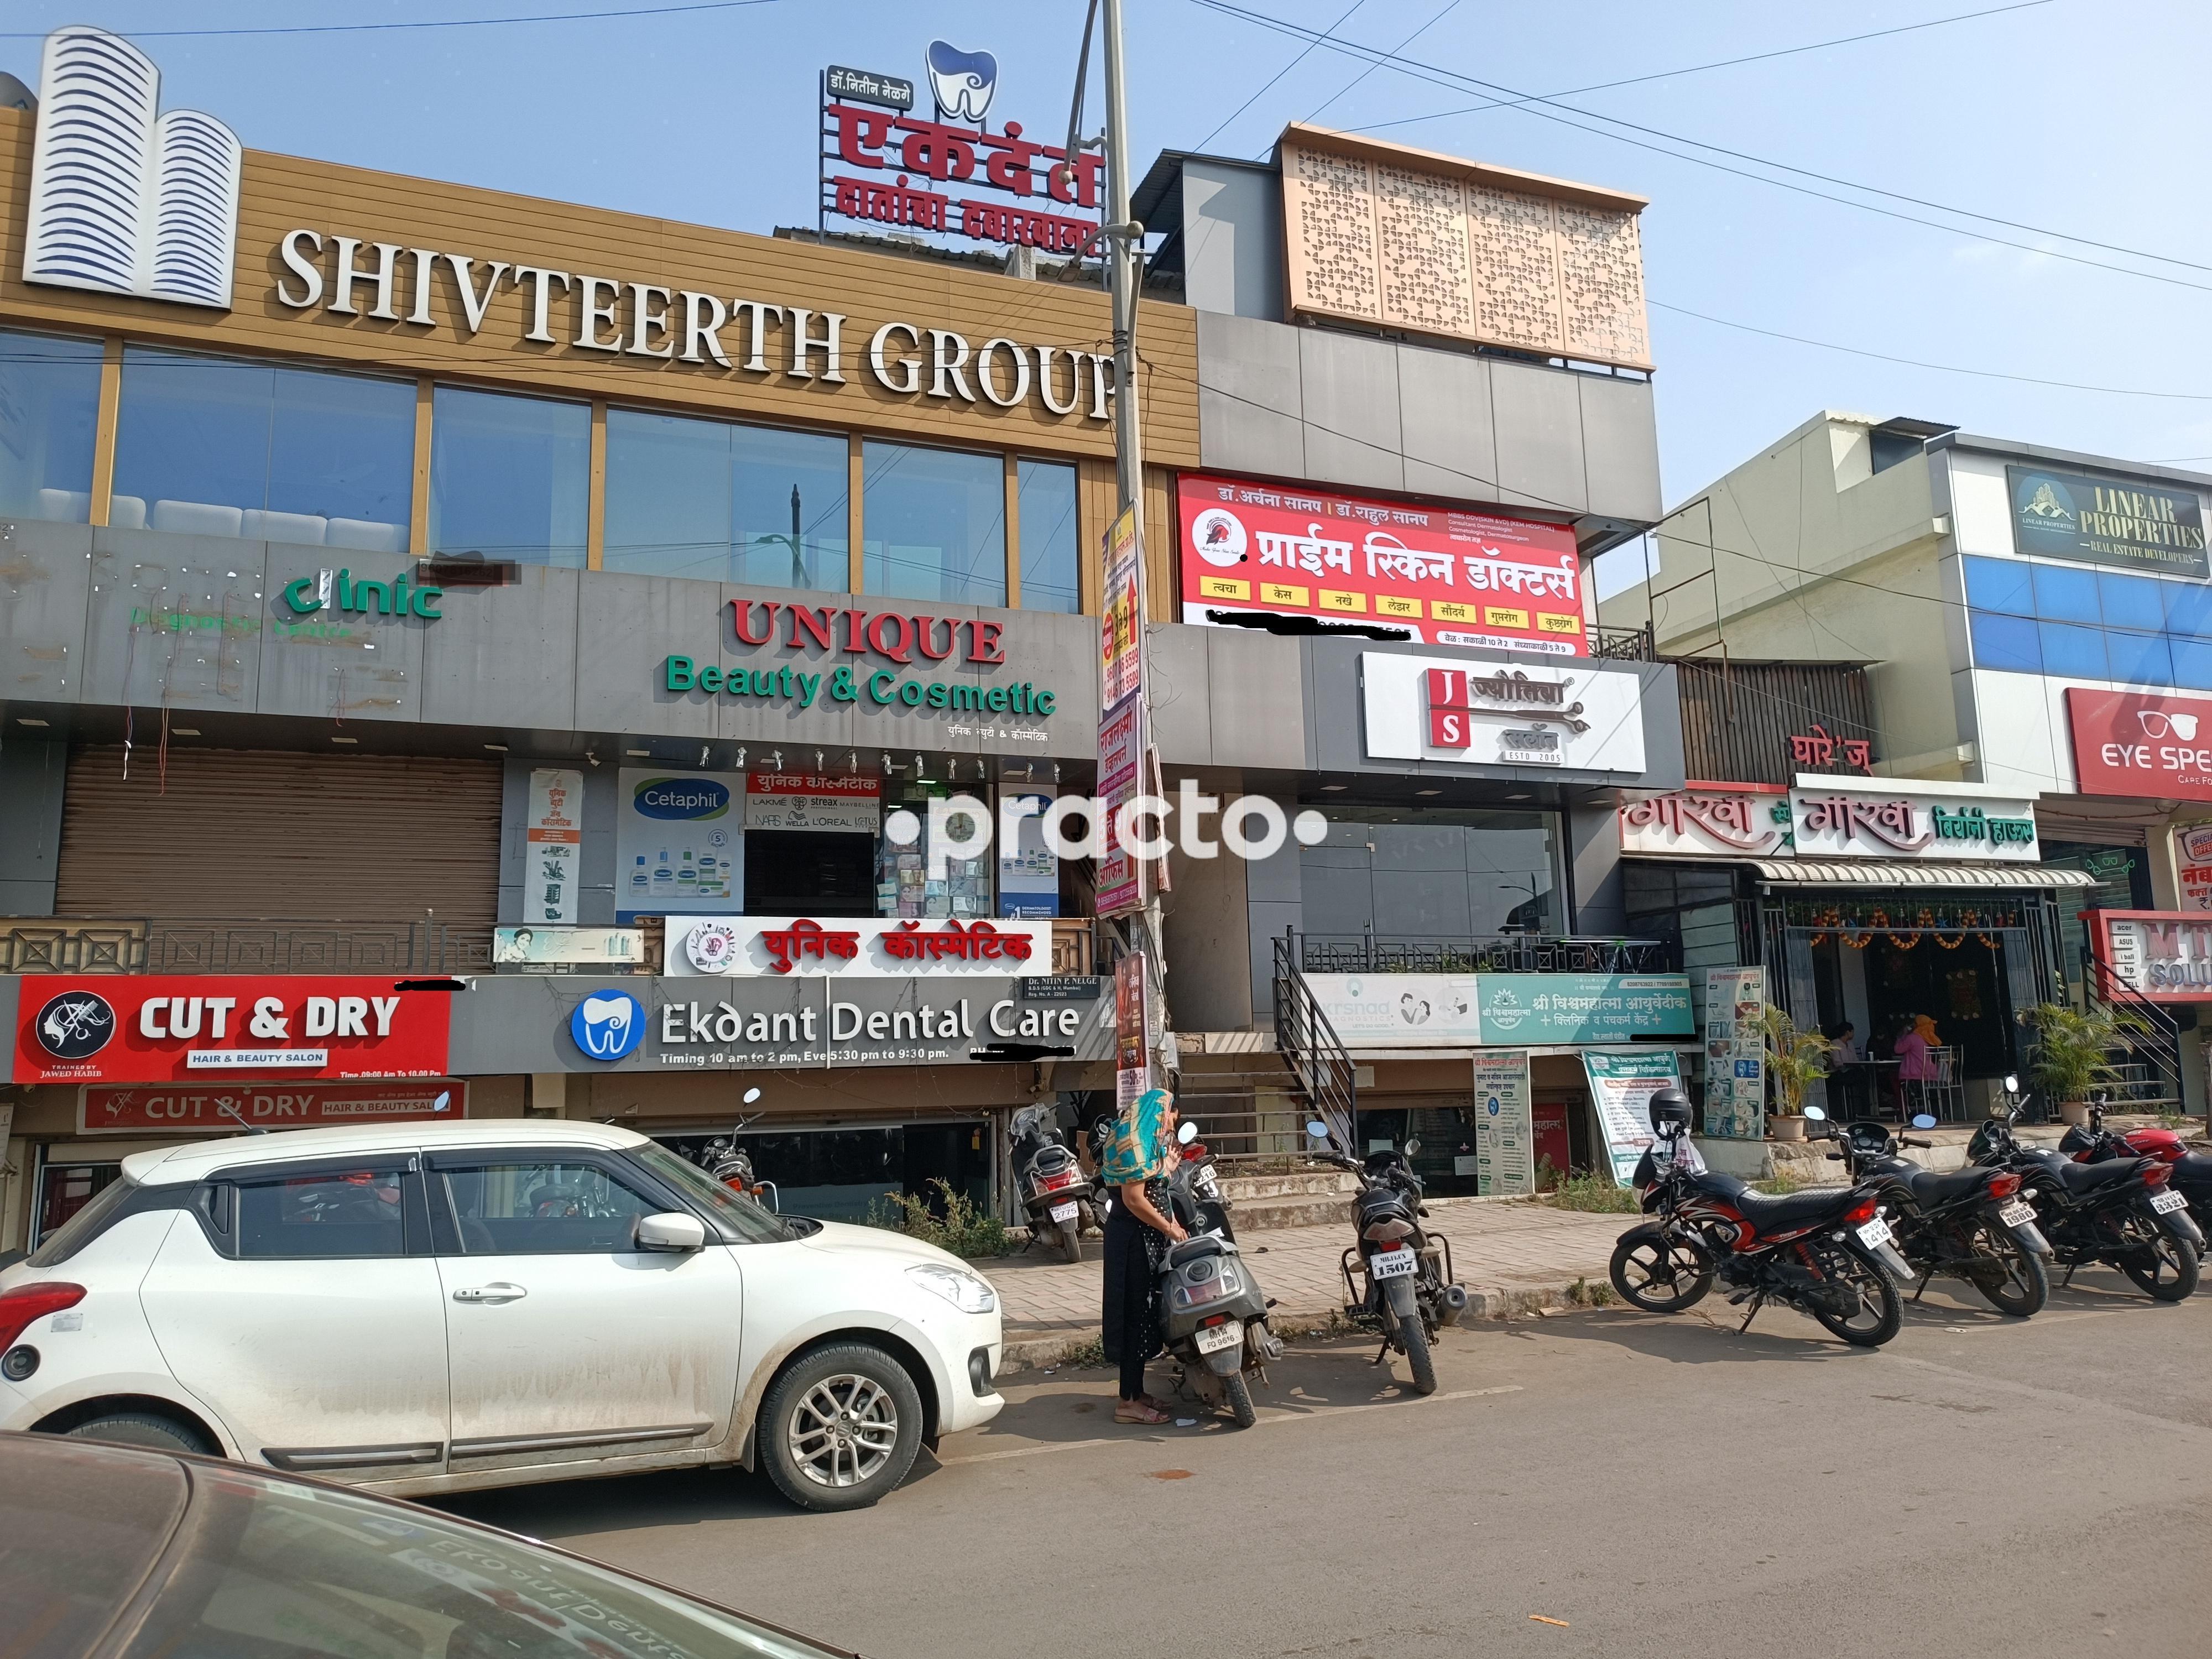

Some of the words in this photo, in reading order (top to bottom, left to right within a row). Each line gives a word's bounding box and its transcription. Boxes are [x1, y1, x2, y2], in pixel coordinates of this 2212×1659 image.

[828, 103, 1105, 208] एकदंत
[833, 174, 948, 231] दातांचा
[278, 228, 847, 383] SHIVTEERTH
[870, 322, 1115, 419] GROUP
[1284, 496, 1321, 513] सानप
[1392, 511, 1428, 526] सानप
[2094, 486, 2177, 523] LINEAR
[1448, 519, 1477, 528] Consultant
[1477, 523, 1512, 533] Dermatologist
[1526, 523, 1554, 533] HOSPITAL)
[2022, 517, 2043, 526] LINEAR
[2043, 520, 2075, 530] PROPERTIES
[2079, 510, 2203, 550] PROPERTIES
[1488, 531, 1529, 541] Dermatosurgeon
[1255, 523, 1353, 577] प्राईम
[1363, 531, 1455, 586] स्किन
[1463, 545, 1575, 600] डॉक्टर्स
[2090, 540, 2112, 554] REAL
[2114, 544, 2143, 559] ESTATE
[2145, 548, 2194, 565] DEVELOPERS
[1213, 582, 1237, 594] त्वचा
[1274, 586, 1292, 600] केस
[1335, 594, 1353, 607] नखे
[730, 599, 1006, 664] UNIQUE
[1463, 636, 1486, 645] सकाळी
[1497, 638, 1503, 646] ते
[1555, 644, 1560, 652] ते
[667, 655, 820, 708] Beauty
[832, 666, 858, 702] &
[869, 669, 1057, 717] Cosmetic
[1441, 672, 1454, 705] J
[999, 729, 1007, 738] &
[1442, 714, 1460, 743] S
[1509, 752, 1530, 761] ESTD
[1540, 753, 1561, 762] 2005
[2102, 743, 2152, 769] EYE
[645, 790, 718, 810] Cetaphil
[811, 797, 838, 806] streax
[1009, 800, 1047, 812] Cetaphil
[1933, 805, 1986, 841] बिर्यानी
[1988, 817, 2034, 846] हाऊस
[760, 919, 861, 973] युनिक
[880, 919, 1034, 961] कॉस्मेटिक
[2124, 966, 2134, 974] hp
[1532, 993, 1549, 1010] श्री
[139, 997, 236, 1039] CUT
[249, 996, 289, 1039] &
[305, 996, 401, 1037] DRY
[831, 999, 973, 1041] Dental
[989, 999, 1079, 1037] Care
[1553, 1013, 1589, 1026] क्लिनिक
[1593, 1015, 1600, 1025] व
[1603, 1013, 1631, 1026] पंचकर्म
[193, 1055, 221, 1063] HAIR
[224, 1055, 232, 1063] &
[237, 1054, 282, 1063] BEAUTY
[286, 1053, 323, 1062] SALON
[660, 1053, 705, 1066] Timing
[709, 1053, 723, 1063] 10
[728, 1055, 748, 1063] am
[751, 1052, 764, 1062] to
[768, 1052, 775, 1062] 2
[779, 1053, 801, 1065] pm,
[804, 1051, 826, 1062] Eve
[830, 1050, 858, 1061] 5:30
[861, 1051, 879, 1062] pm
[882, 1050, 895, 1060] to
[898, 1048, 925, 1059] 9:30
[927, 1049, 950, 1061] pm.
[40, 1070, 72, 1078] JAWED
[145, 1096, 208, 1119] CUT
[216, 1095, 242, 1118] &
[253, 1094, 314, 1118] DRY
[324, 1103, 352, 1113] HAIR
[354, 1103, 364, 1112] &
[368, 1102, 410, 1111] BEAUTY
[1055, 1208, 1077, 1219] 2775
[2156, 1197, 2185, 1213] 3321
[2006, 1210, 2033, 1225] 1980
[1865, 1227, 1889, 1246] 1414
[1376, 1260, 1413, 1276] 1507
[1218, 1335, 1235, 1346] 9616
